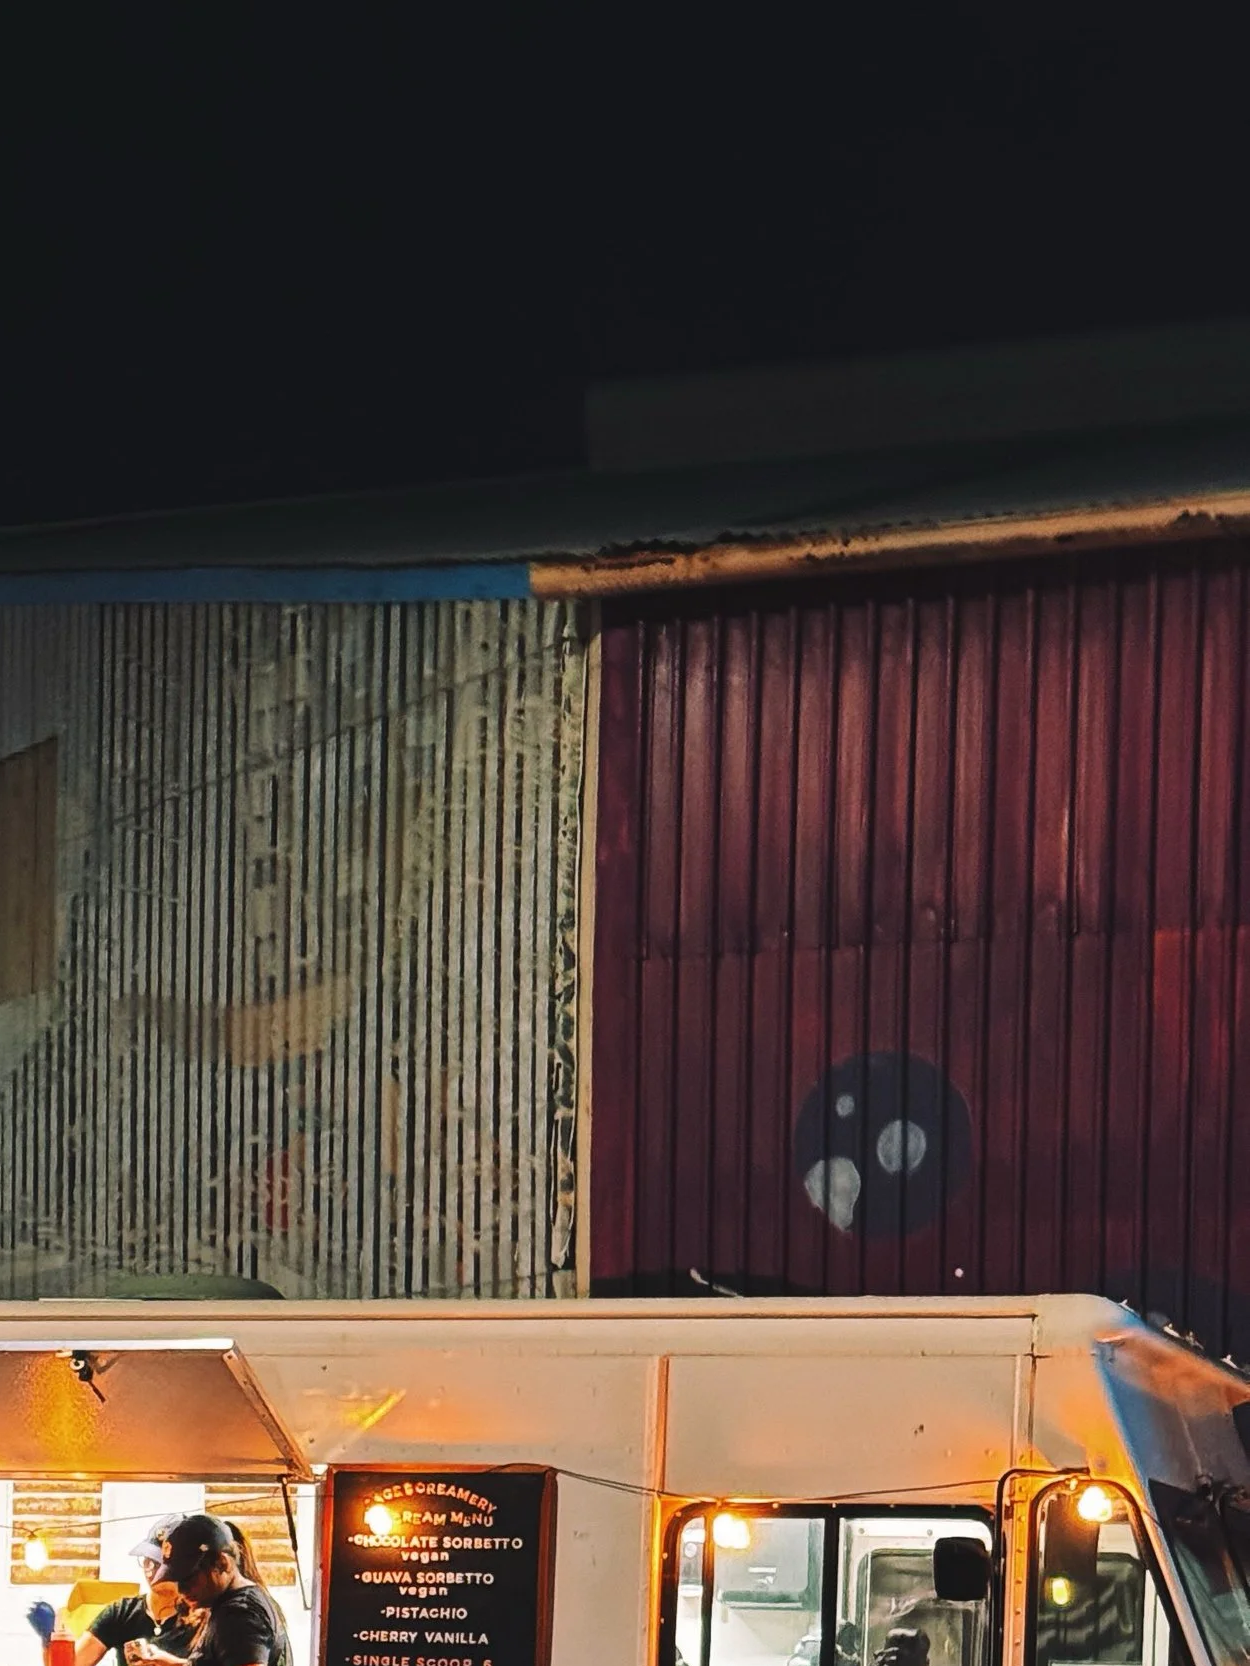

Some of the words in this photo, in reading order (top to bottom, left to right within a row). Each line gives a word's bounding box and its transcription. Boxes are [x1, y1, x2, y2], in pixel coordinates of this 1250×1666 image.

[450, 1511, 494, 1528] MENU
[353, 1534, 439, 1549] CHOCOLATE
[442, 1536, 523, 1550] SORBETTO
[401, 1551, 450, 1564] vegan
[361, 1571, 413, 1584] GUAVA
[416, 1572, 495, 1585] SORBETTO
[399, 1586, 449, 1598] vegan
[385, 1606, 468, 1620] PISTACHIO
[359, 1630, 418, 1644] CHERRY
[424, 1631, 489, 1645] VANILLA
